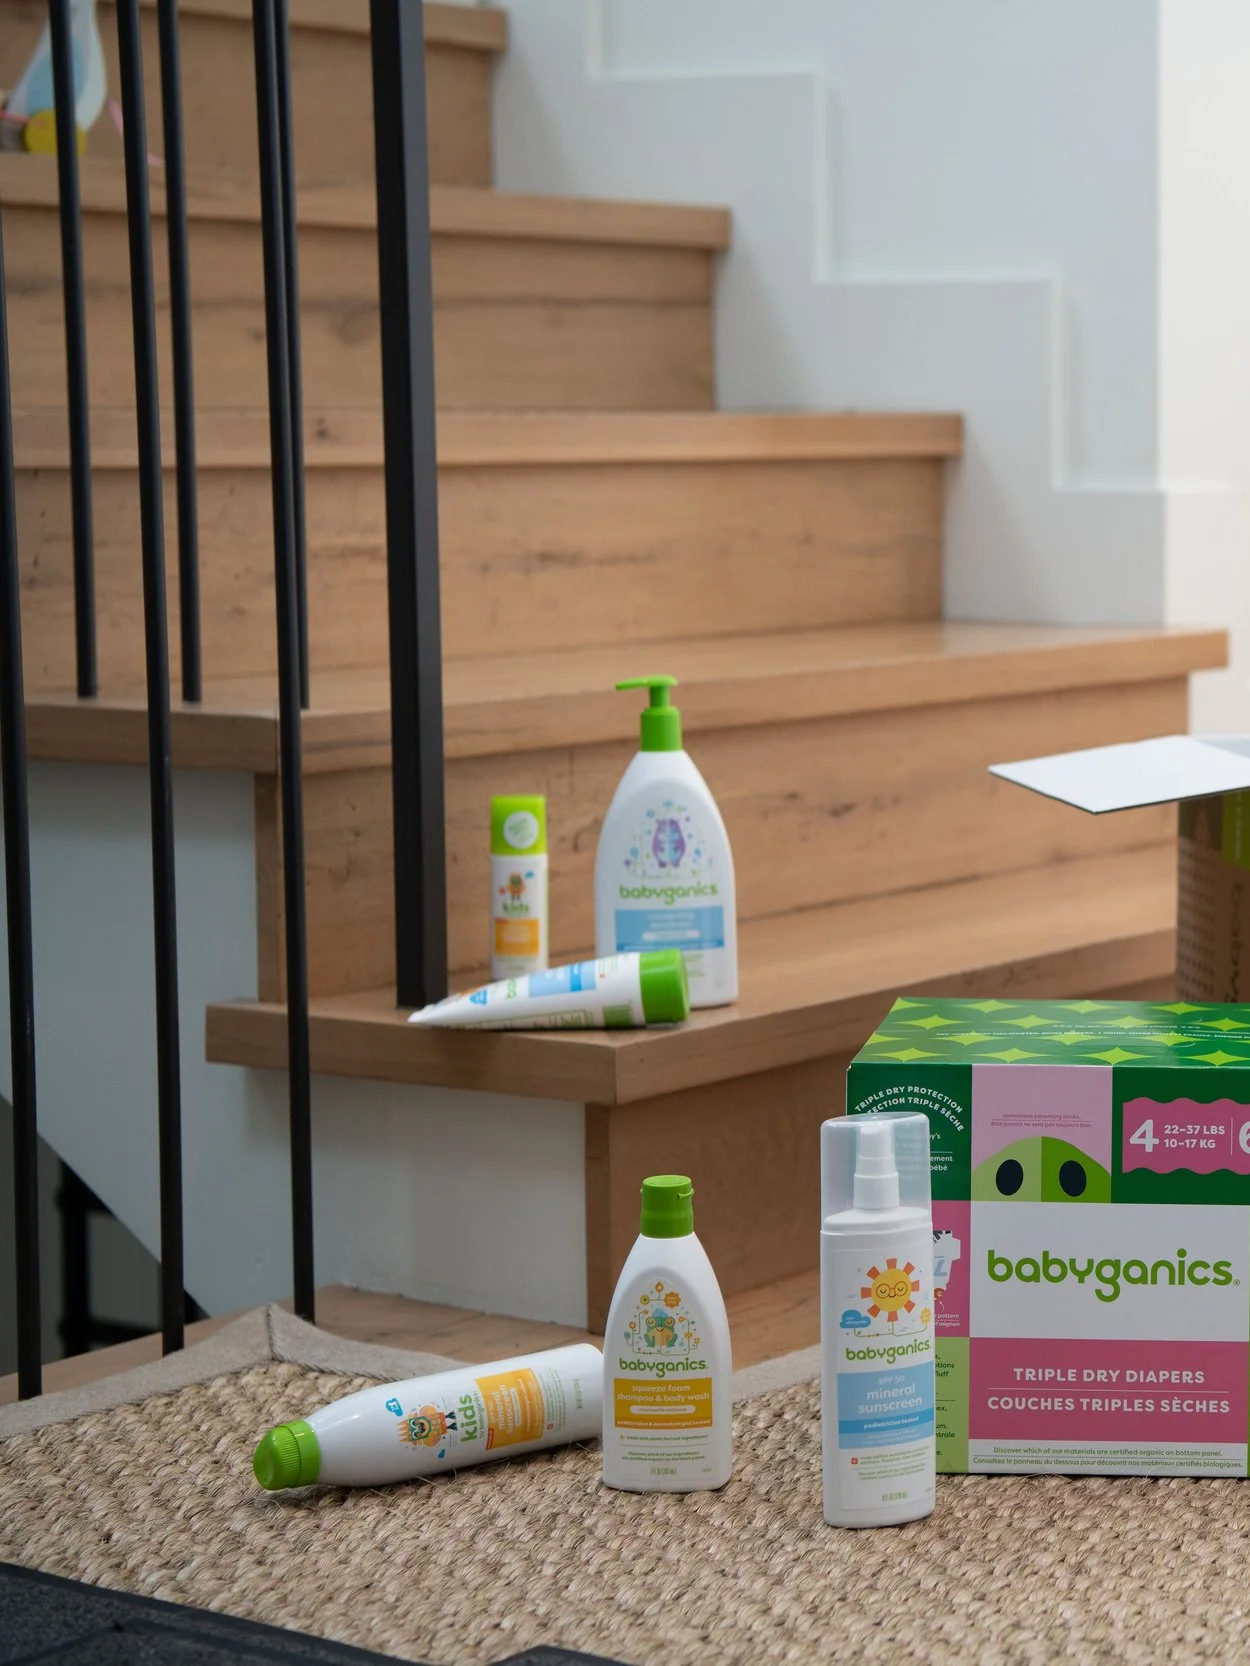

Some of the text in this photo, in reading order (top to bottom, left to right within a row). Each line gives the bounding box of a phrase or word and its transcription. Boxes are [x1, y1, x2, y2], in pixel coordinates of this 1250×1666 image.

[619, 881, 718, 905] babyganics
[855, 1086, 963, 1113] TRIPLE DRY PROTECTION
[907, 1097, 940, 1110] TRIPLE
[940, 1108, 964, 1132] SÈCHE
[1129, 1119, 1160, 1152] 4
[1202, 1124, 1226, 1134] LBS
[1200, 1139, 1216, 1149] KG
[987, 1248, 1233, 1302] babyganics
[845, 1338, 930, 1364] babyganics
[619, 1356, 706, 1378] babyganics
[894, 1374, 905, 1383] 50
[1013, 1368, 1205, 1384] TRIPLE DRY DIAPERS
[617, 1393, 654, 1402] shampoo
[664, 1394, 686, 1402] body
[866, 1382, 915, 1400] mineral
[492, 1392, 504, 1430] mineral
[500, 1384, 514, 1434] sunscreen
[858, 1397, 922, 1414] sunscreen
[987, 1396, 1230, 1413] COUCHES TRIPLES SÈCHES
[458, 1394, 478, 1442] kids
